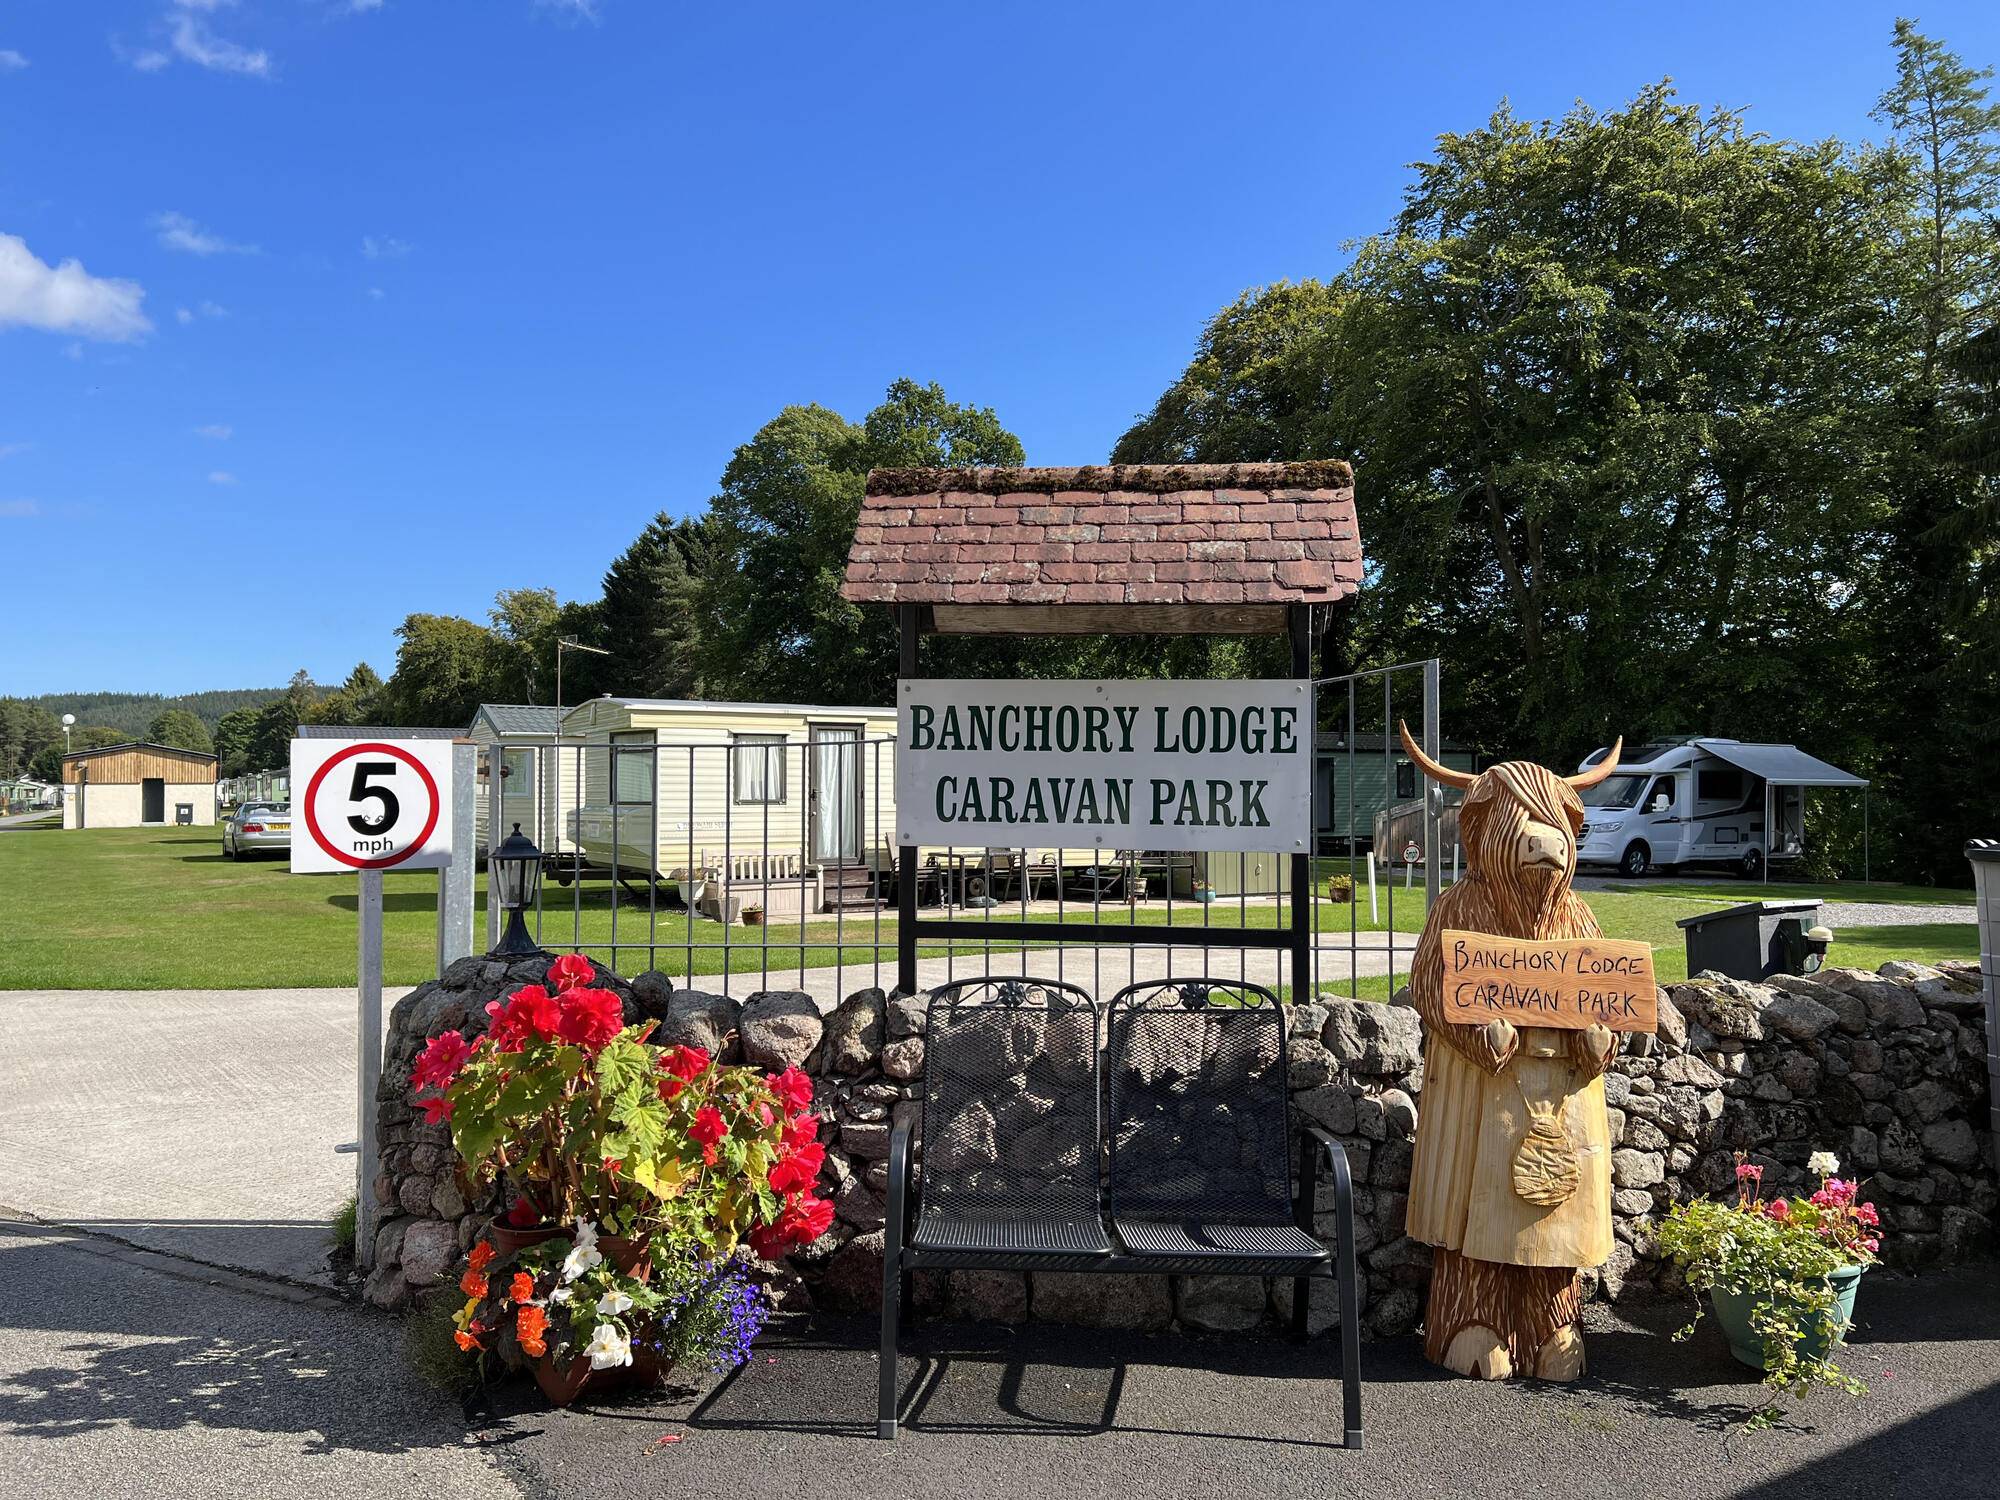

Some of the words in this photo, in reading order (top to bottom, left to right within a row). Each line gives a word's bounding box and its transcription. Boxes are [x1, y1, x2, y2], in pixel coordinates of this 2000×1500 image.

[909, 704, 1139, 753] BANCHORY
[1154, 705, 1298, 754] LODGE
[347, 762, 400, 836] 5
[936, 775, 1134, 824] CARAVAN
[1150, 778, 1271, 828] PARK
[353, 837, 394, 855] mph
[1454, 940, 1569, 974] BANCHORY
[1577, 950, 1645, 975] LODGE
[1455, 982, 1559, 1012] CARAVAN
[1578, 989, 1639, 1018] PARK
